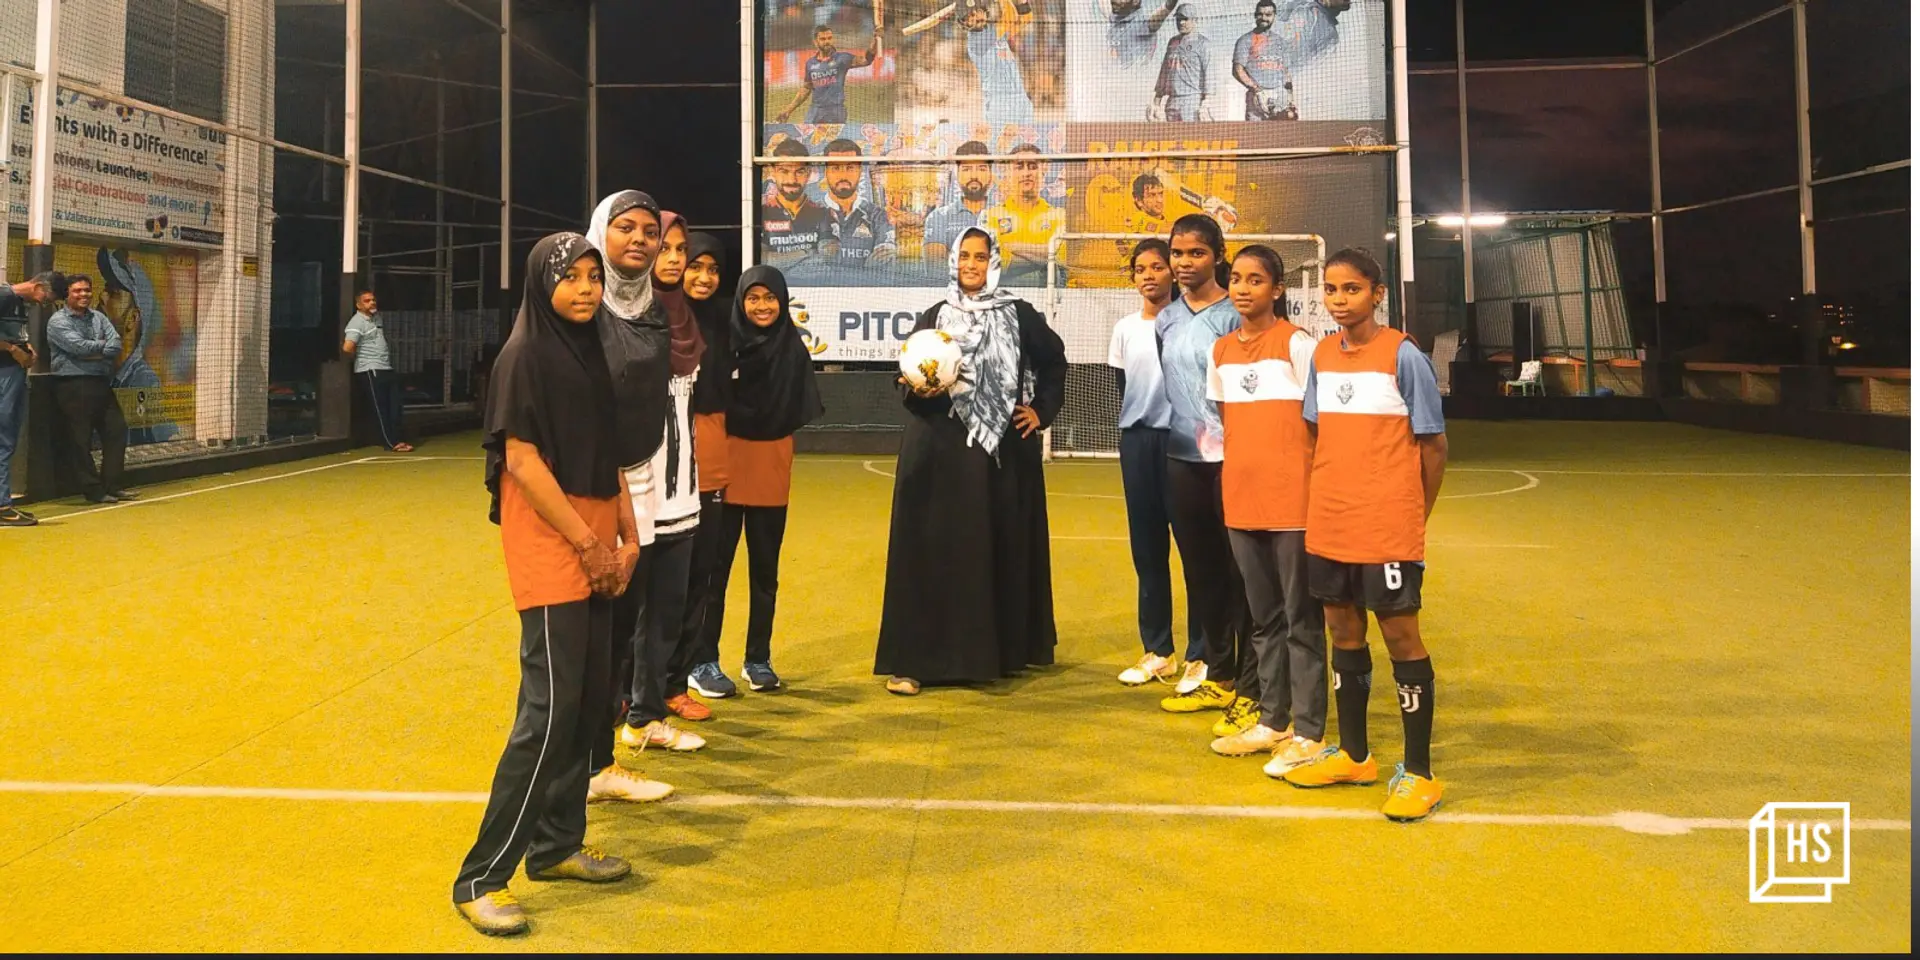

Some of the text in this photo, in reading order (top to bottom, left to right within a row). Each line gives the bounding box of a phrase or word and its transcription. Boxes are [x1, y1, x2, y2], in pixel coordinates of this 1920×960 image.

[20, 104, 79, 135] Ents
[83, 120, 118, 144] with
[121, 132, 130, 148] a
[133, 132, 208, 166] Difference!
[96, 158, 151, 184] Launches,
[74, 180, 146, 204] Celebrations
[147, 193, 167, 208] and
[839, 346, 883, 358] things
[1384, 561, 1402, 590] 6
